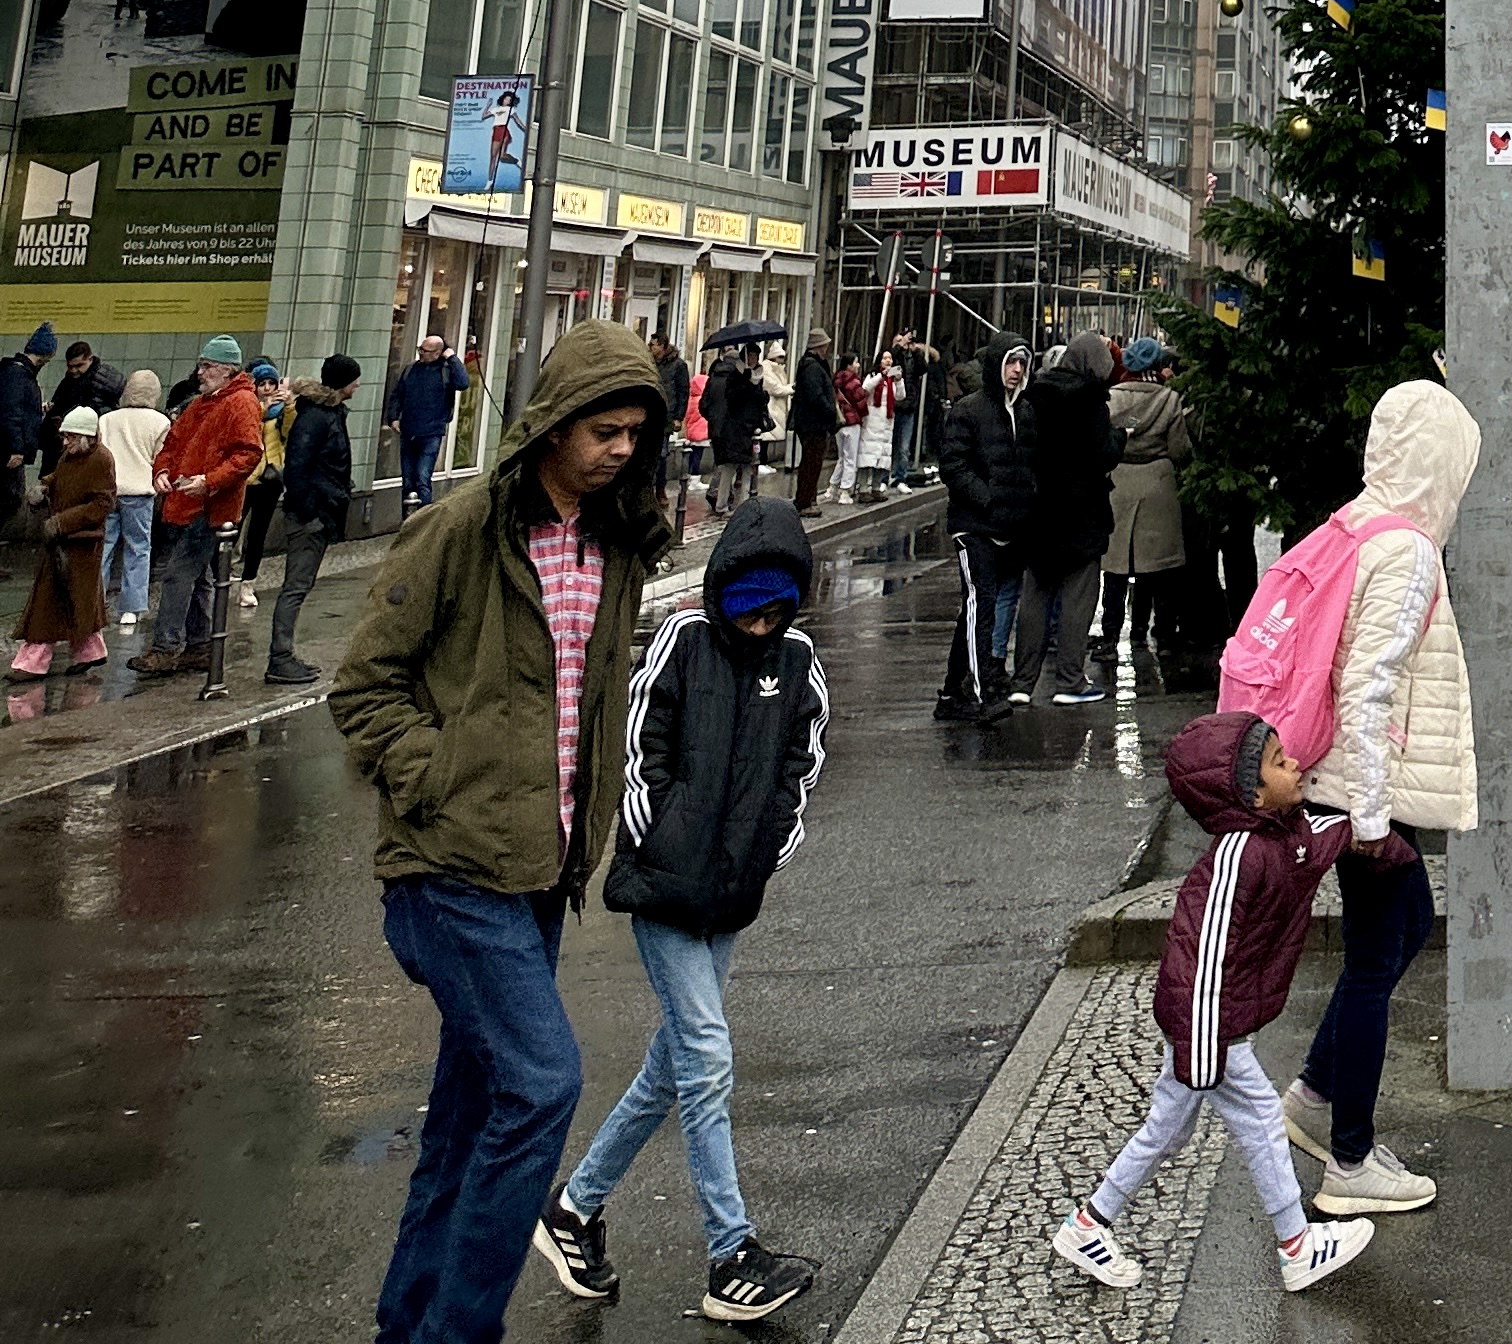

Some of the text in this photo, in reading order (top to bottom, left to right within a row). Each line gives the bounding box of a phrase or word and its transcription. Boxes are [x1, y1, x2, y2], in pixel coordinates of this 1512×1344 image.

[147, 66, 248, 100] COME
[456, 81, 528, 90] DESTINATION
[455, 90, 488, 100] STYLE
[145, 113, 262, 141] AND BE
[854, 135, 1042, 168] MUSEUM
[131, 151, 282, 180] PART OF
[1063, 148, 1133, 220] MAUERMUSEUM
[17, 223, 90, 247] MAUER
[125, 222, 275, 234] Unser Museum ist an allen
[123, 238, 144, 250] des
[145, 238, 185, 250] Jahres
[186, 240, 208, 250] von
[208, 238, 218, 250] 9
[219, 237, 237, 249] bis
[238, 237, 254, 249] 22
[14, 246, 87, 266] MUSEUM
[121, 252, 273, 266] Tickets hier im Shop erhäl
